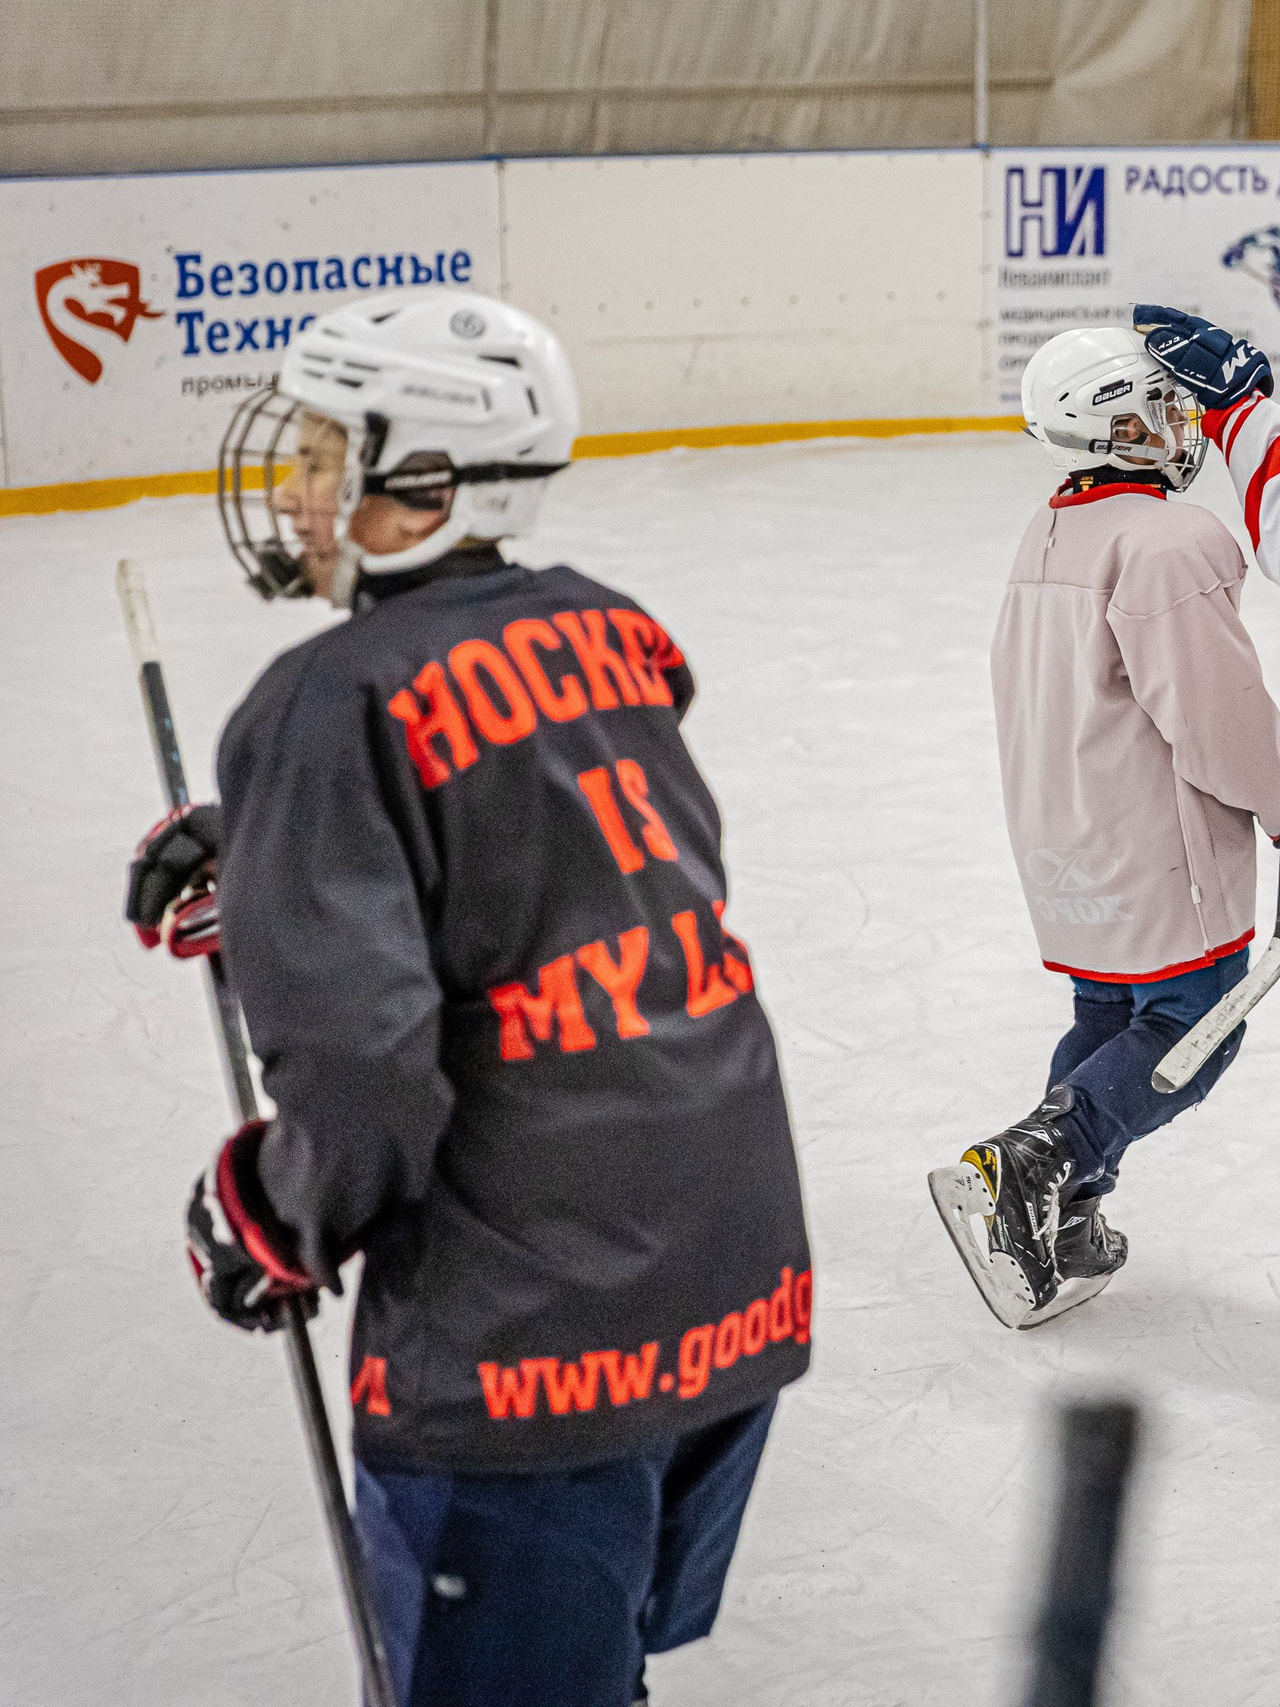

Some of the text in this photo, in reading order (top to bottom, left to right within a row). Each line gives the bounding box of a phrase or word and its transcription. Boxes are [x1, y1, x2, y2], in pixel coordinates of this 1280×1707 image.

[1005, 166, 1106, 258] НИ
[1124, 165, 1268, 198] РАДОСТЬ
[174, 248, 472, 299] Безопасные
[1094, 384, 1132, 404] BAUER
[578, 759, 678, 875] IS
[487, 926, 651, 1060] MY
